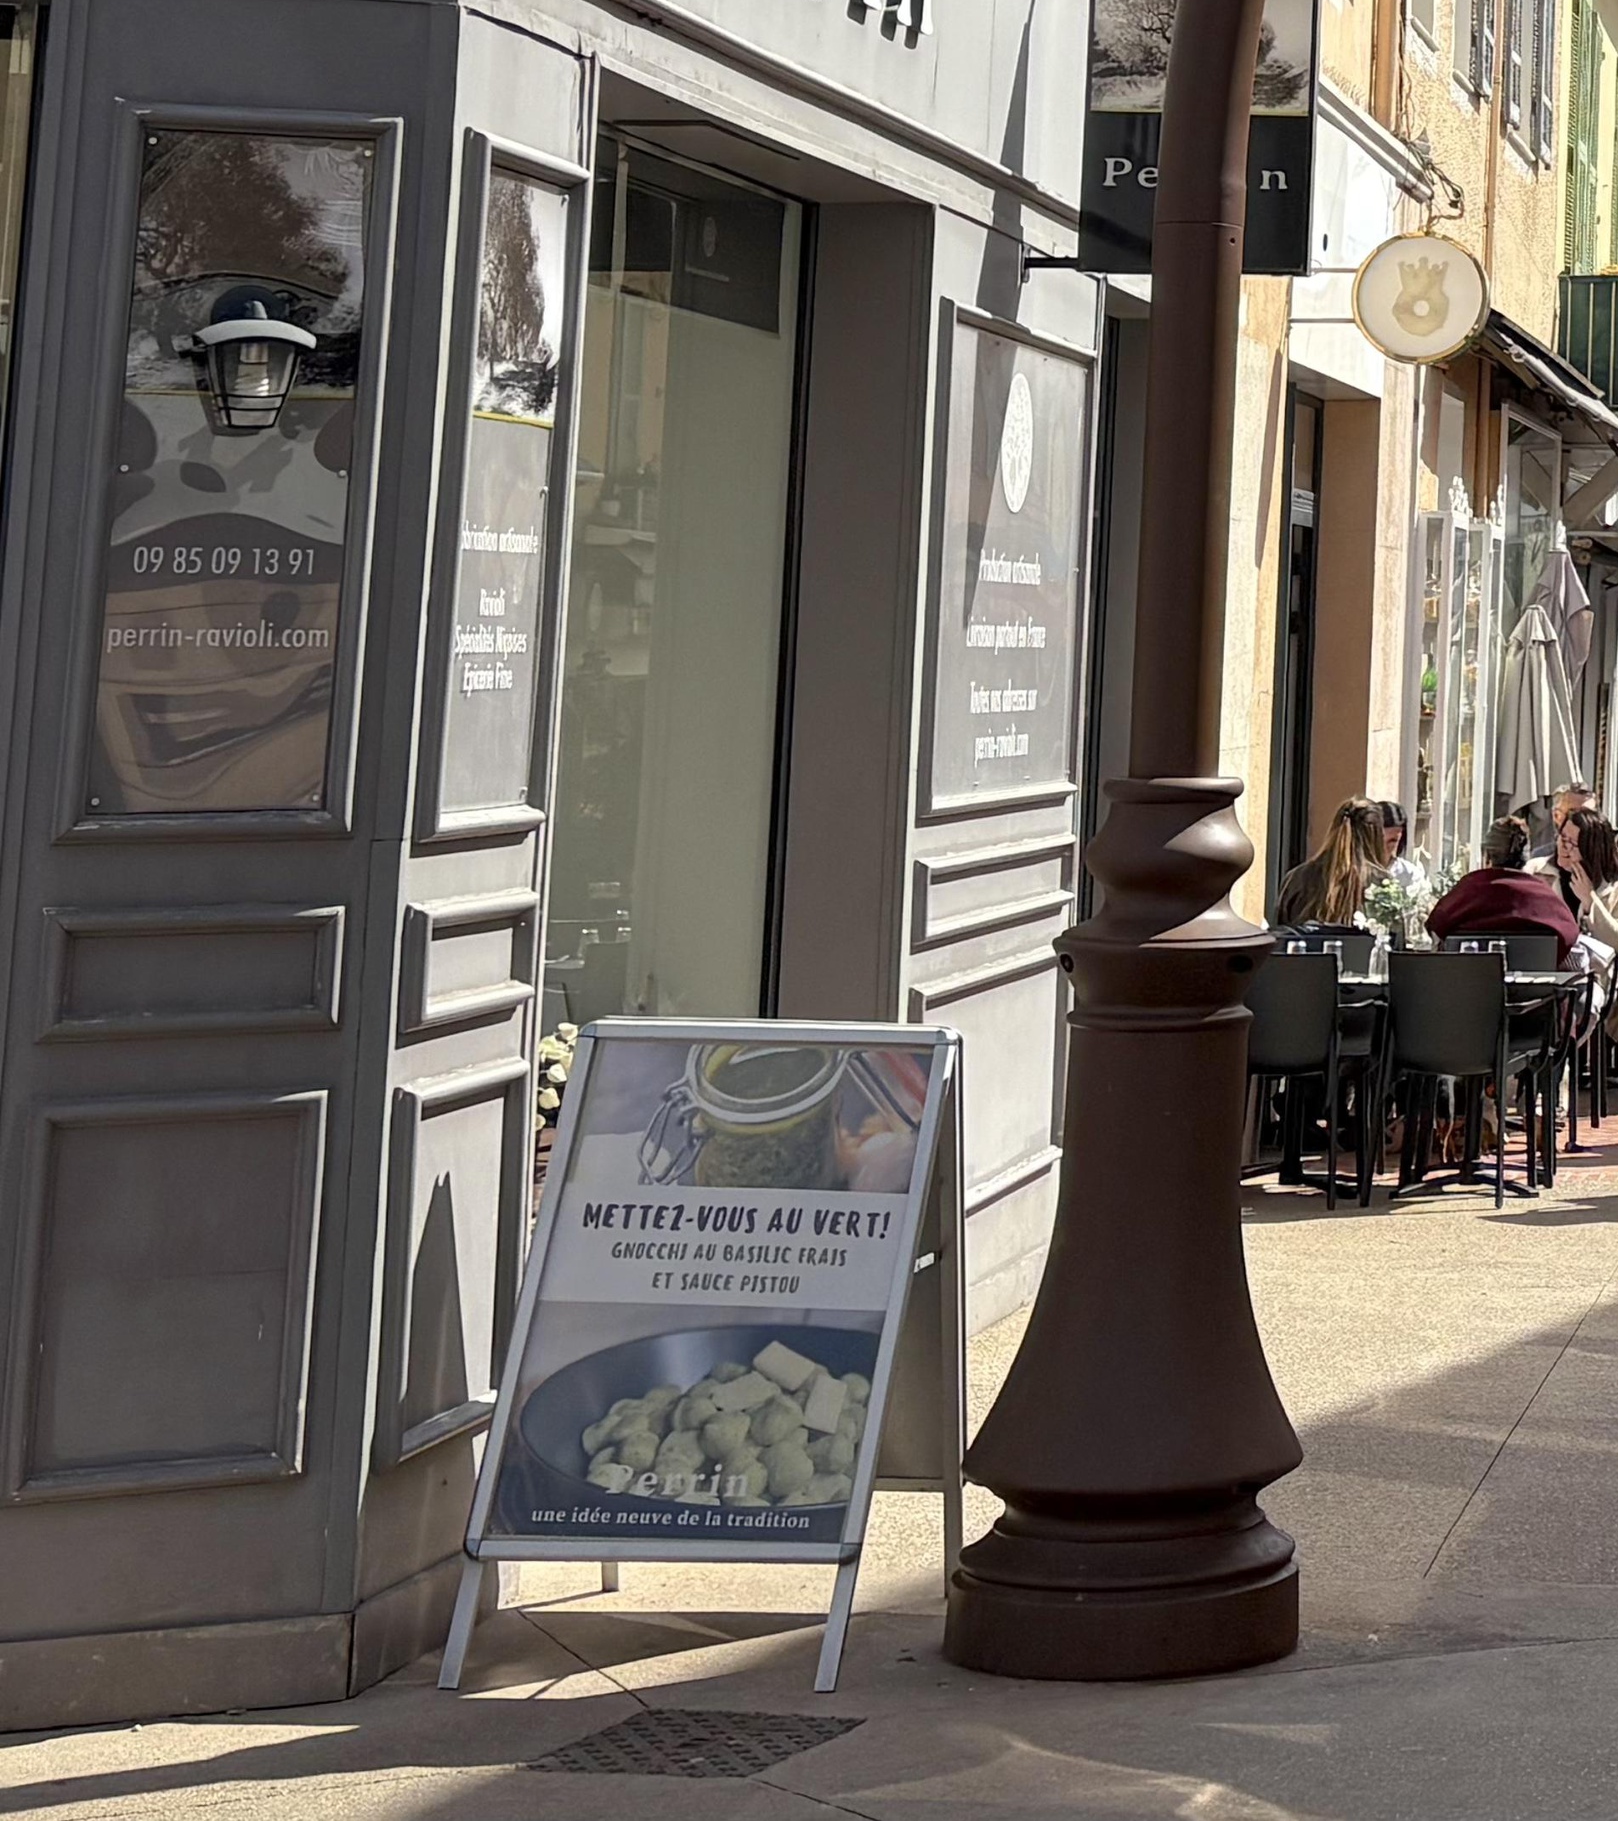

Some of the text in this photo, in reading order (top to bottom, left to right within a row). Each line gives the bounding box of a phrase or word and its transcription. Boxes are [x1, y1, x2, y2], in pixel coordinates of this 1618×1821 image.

[1102, 156, 1288, 190] Pen
[133, 546, 315, 575] 09 85 09 13 91
[479, 587, 506, 617] Ravioli
[106, 618, 330, 653] perrin-ravioli.com
[494, 661, 513, 690] Fine
[581, 1201, 891, 1240] METTEZ-VOUS AU VERT!
[611, 1241, 848, 1267] GNOCCHI AU BASILIC FRAIS
[651, 1271, 801, 1294] ET SAUCE PISTOU
[605, 1462, 749, 1498] Perrin
[531, 1506, 810, 1529] une idée neuve de la tradition
